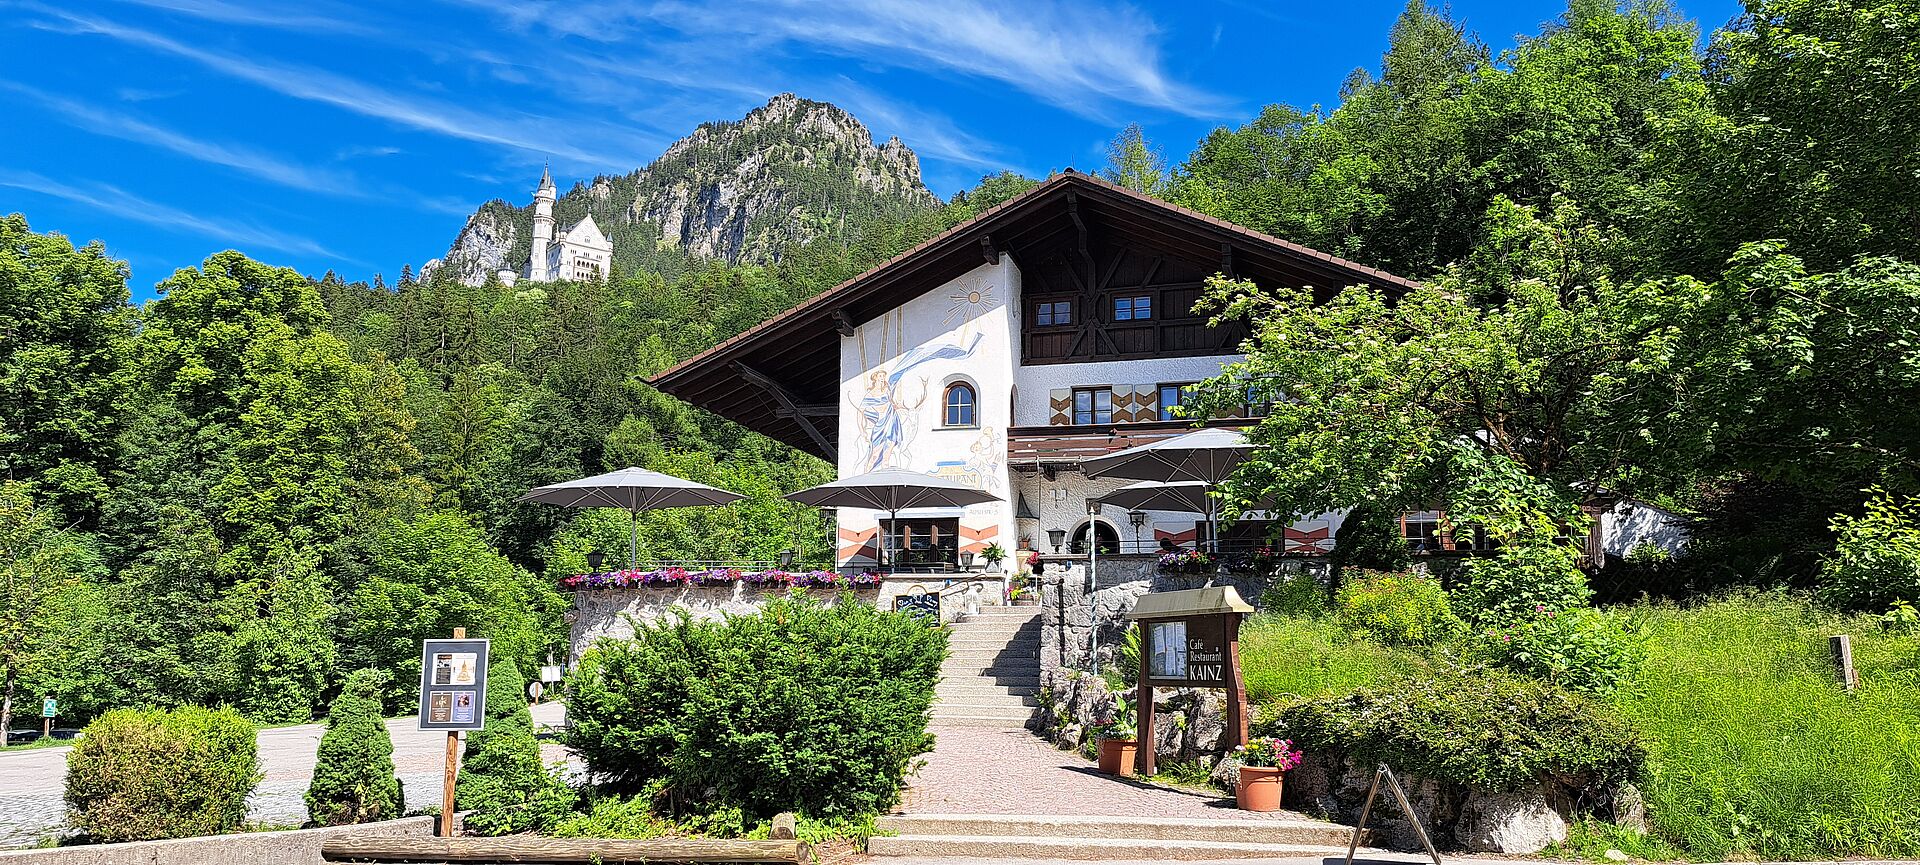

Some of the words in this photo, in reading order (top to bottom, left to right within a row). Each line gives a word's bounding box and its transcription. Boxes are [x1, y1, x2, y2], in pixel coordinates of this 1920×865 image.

[1190, 638, 1203, 650] Café
[1190, 650, 1222, 662] Restaurant
[1190, 664, 1223, 681] KAINZ
